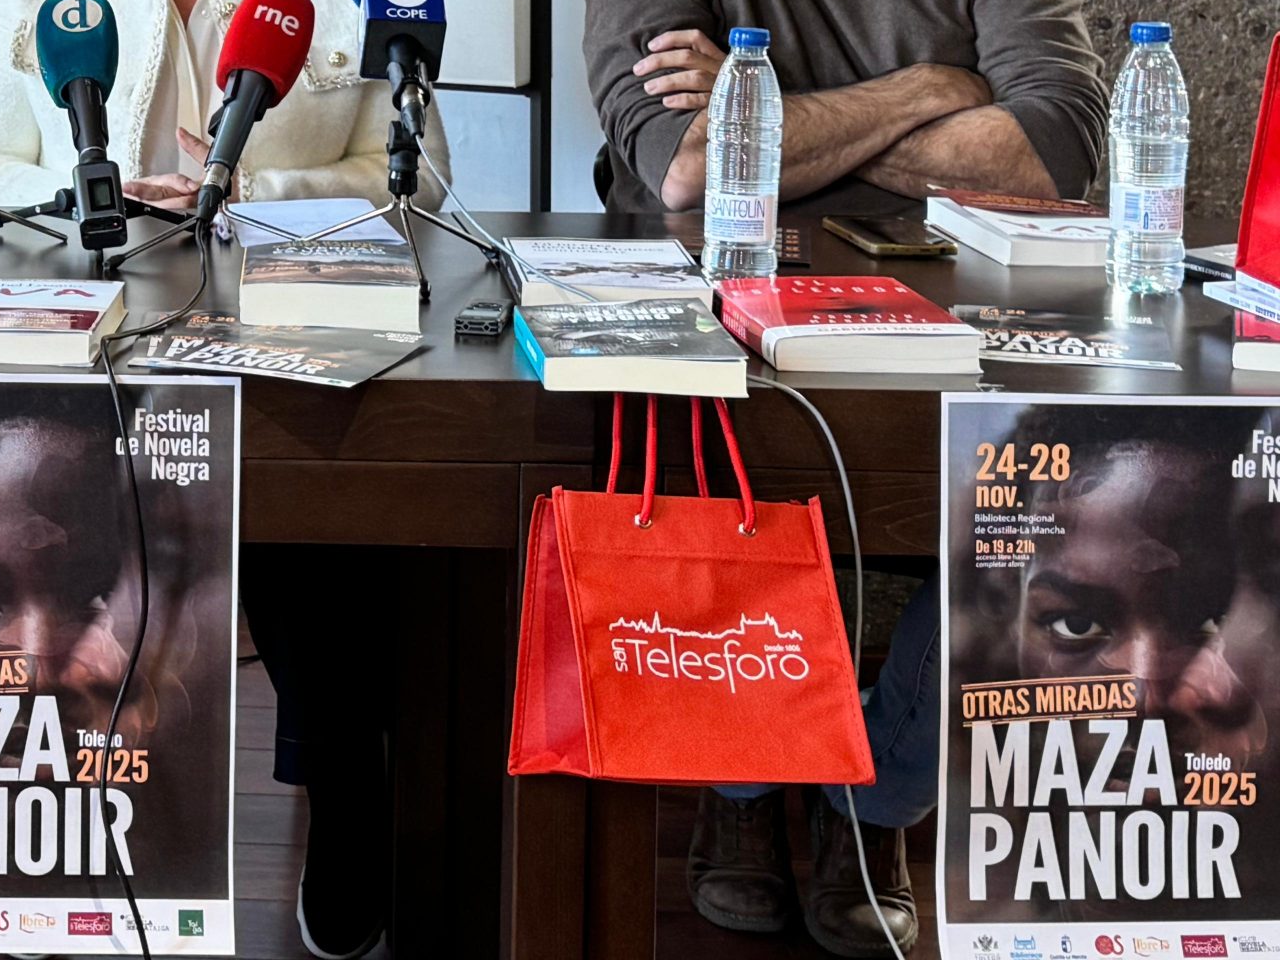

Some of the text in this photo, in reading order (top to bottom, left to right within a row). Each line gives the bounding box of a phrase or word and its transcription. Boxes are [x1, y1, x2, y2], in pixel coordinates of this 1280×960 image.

[252, 3, 301, 37] rne
[385, 7, 428, 19] COPE
[710, 197, 766, 218] SANTOLÍN
[978, 339, 1123, 358] PANOIR
[982, 329, 1088, 348] MAZA
[180, 350, 326, 375] PANOIR
[205, 345, 306, 363] MAZA
[134, 408, 210, 433] Festival
[144, 432, 210, 457] Novela
[151, 456, 210, 486] Negra
[975, 442, 1070, 481] 24-28
[1232, 454, 1280, 479] de N
[975, 485, 1024, 508] nov.
[974, 513, 1055, 525] Biblioteca Regional
[974, 526, 1066, 535] de Castilla-La Mancha
[975, 539, 1036, 554] De 19 a 21h
[611, 634, 810, 694] san Telesforo
[962, 682, 1137, 720] OTRAS MIRADAS
[76, 729, 122, 748] Toleo
[970, 718, 1178, 808] MAZA
[1184, 752, 1231, 771] Toledo
[1183, 772, 1257, 806] 2025
[969, 810, 1242, 901] PANOIR
